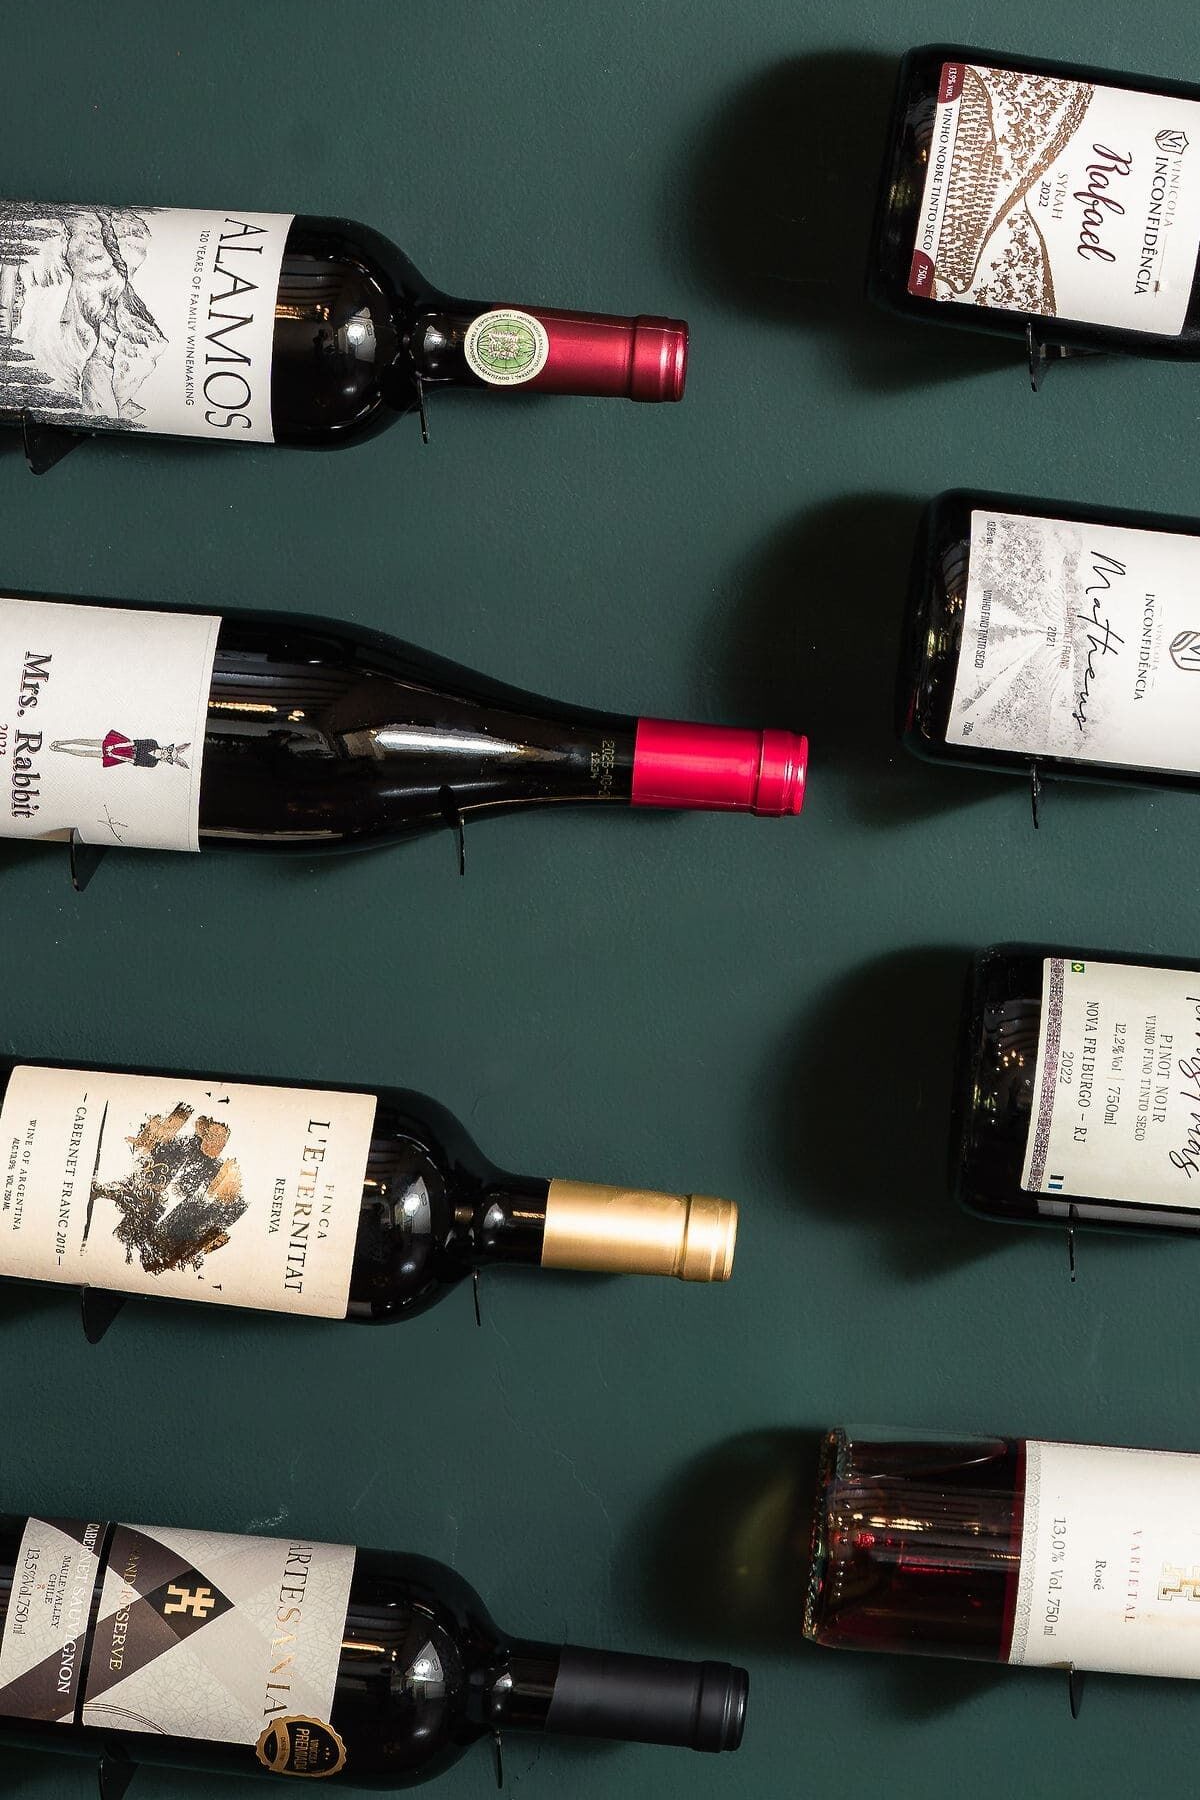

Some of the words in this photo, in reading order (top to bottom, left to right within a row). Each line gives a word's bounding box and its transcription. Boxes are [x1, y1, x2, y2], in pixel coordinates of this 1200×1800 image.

[1038, 181, 1052, 207] 2022
[1074, 144, 1133, 263] Rafael
[200, 230, 211, 243] 120
[1134, 156, 1168, 295] INCONFIDÊNCIA
[194, 246, 206, 273] YEARS
[192, 276, 202, 291] OF
[187, 294, 199, 331] FAMILY
[203, 218, 270, 429] ALAMOS
[185, 336, 195, 406] WINEMAKING
[1046, 627, 1057, 647] 2021
[1071, 551, 1125, 731] Matheus
[1134, 593, 1156, 700] INCONFIDÊNCIA
[18, 651, 52, 717] Mrs.
[11, 729, 43, 819] Rabbit
[1083, 1001, 1100, 1032] NOVA
[1144, 1015, 1157, 1045] VINHO
[1060, 1051, 1074, 1085] 2022
[1078, 1037, 1096, 1107] FRIBURGO
[1141, 1048, 1154, 1075] FINO
[1157, 1033, 1174, 1080] PINOT
[1104, 1086, 1121, 1125] 750ml
[1138, 1078, 1150, 1111] TINTO
[1152, 1086, 1169, 1123] NOIR
[24, 1120, 37, 1147] WINE
[65, 1106, 88, 1177] CABERNET
[1073, 1127, 1087, 1143] RJ
[1134, 1115, 1146, 1141] SECO
[22, 1151, 31, 1165] OF
[12, 1169, 27, 1231] ARGENTINA
[58, 1182, 74, 1227] FRANC
[268, 1178, 287, 1234] RESERVA
[284, 1119, 331, 1294] L'ETERNITAT
[317, 1184, 335, 1240] FINCA
[56, 1232, 67, 1255] 2018
[75, 1523, 100, 1584] CABERNET
[1051, 1517, 1067, 1563] 13,0%
[44, 1574, 57, 1604] CHILE
[58, 1556, 71, 1587] MAULE
[1048, 1570, 1063, 1594] Vol.
[1094, 1560, 1107, 1590] Rosé
[1124, 1530, 1142, 1623] VARIETAL
[51, 1589, 64, 1628] VALLEY
[1045, 1600, 1061, 1623] 750
[58, 1586, 84, 1694] SAUVIGNON
[109, 1591, 132, 1670] RESERVE
[263, 1543, 314, 1716] ARTESANIA
[1044, 1626, 1057, 1636] ml
